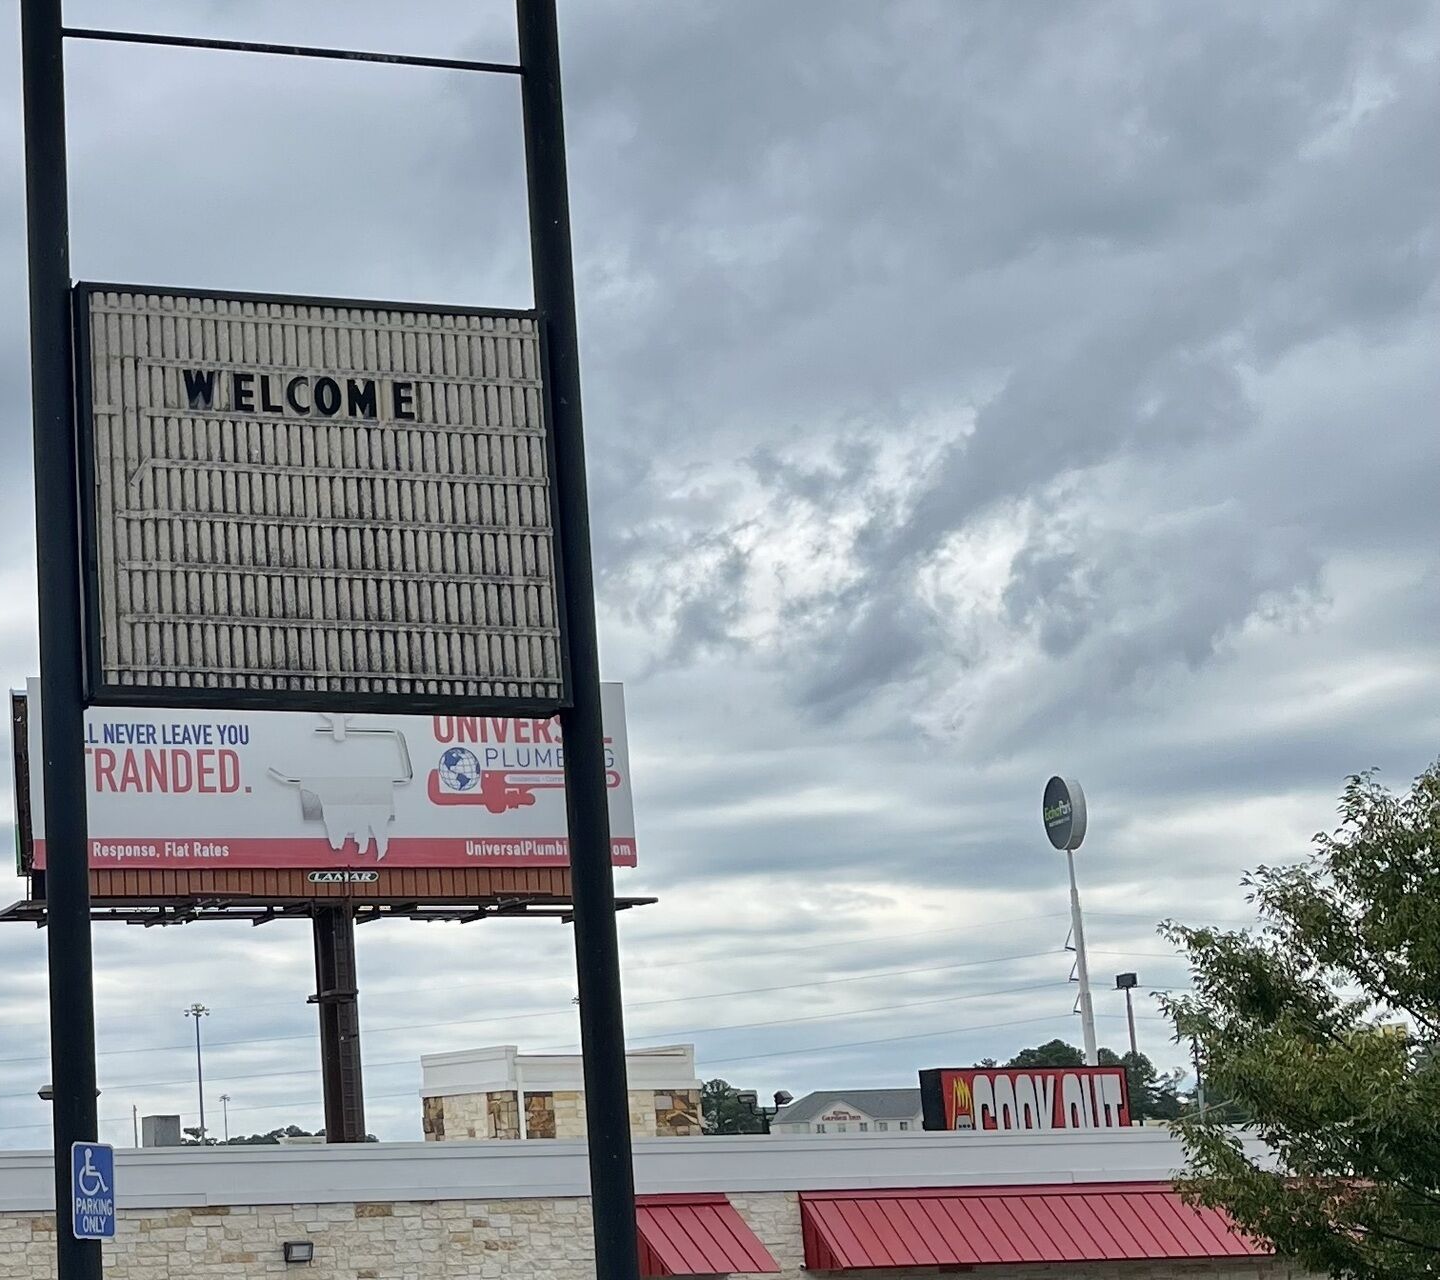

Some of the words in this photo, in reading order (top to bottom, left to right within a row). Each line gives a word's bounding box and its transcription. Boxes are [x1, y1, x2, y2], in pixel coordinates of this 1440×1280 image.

[182, 368, 417, 420] WELCOME
[103, 723, 157, 745] NEVER
[162, 724, 213, 745] LEAVE
[216, 724, 249, 746] YOU
[164, 841, 190, 858] Flat
[193, 841, 229, 858] Rates
[76, 1198, 113, 1216] PARKING
[82, 1216, 107, 1233] ONLY
